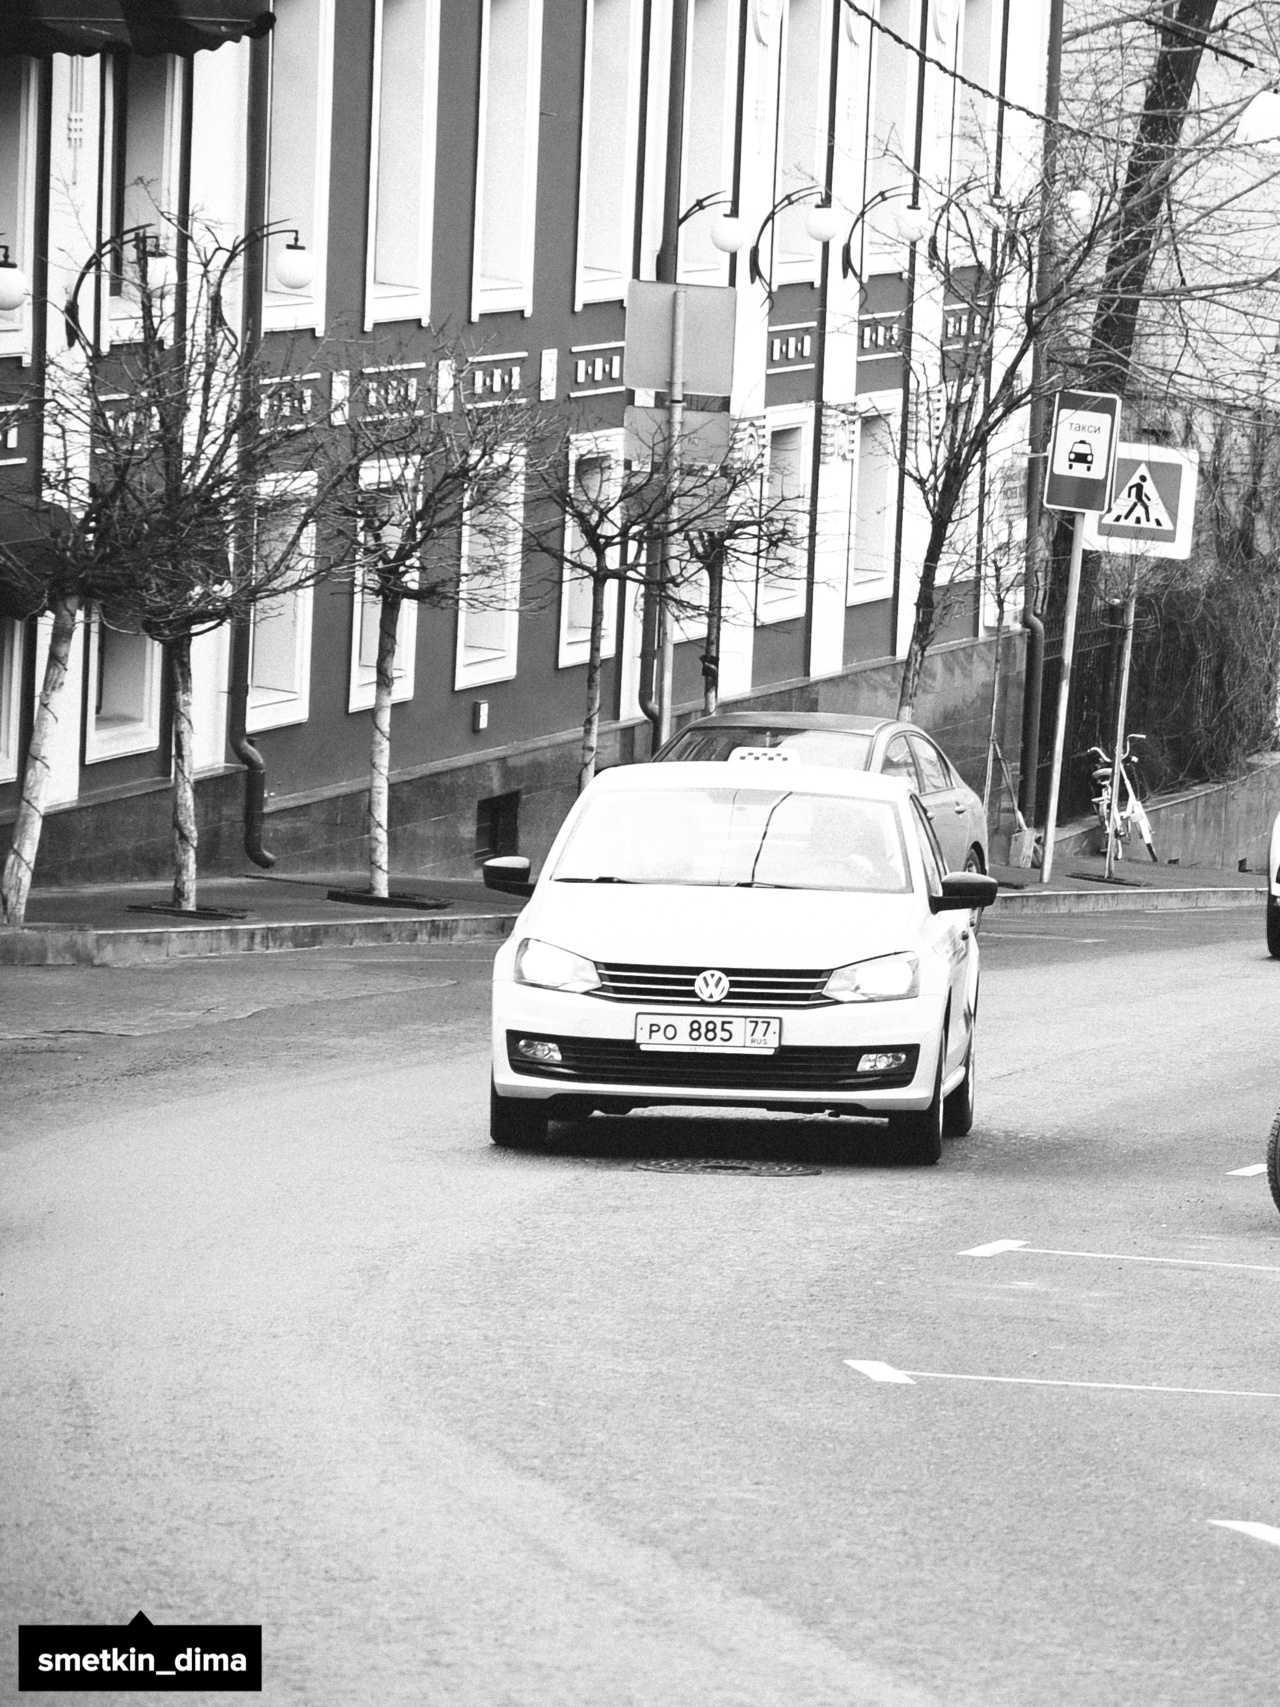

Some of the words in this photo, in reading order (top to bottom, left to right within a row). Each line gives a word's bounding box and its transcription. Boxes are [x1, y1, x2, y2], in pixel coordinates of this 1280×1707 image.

[689, 1019, 733, 1042] 885
[749, 1020, 771, 1037] 77
[750, 1037, 768, 1045] RUS
